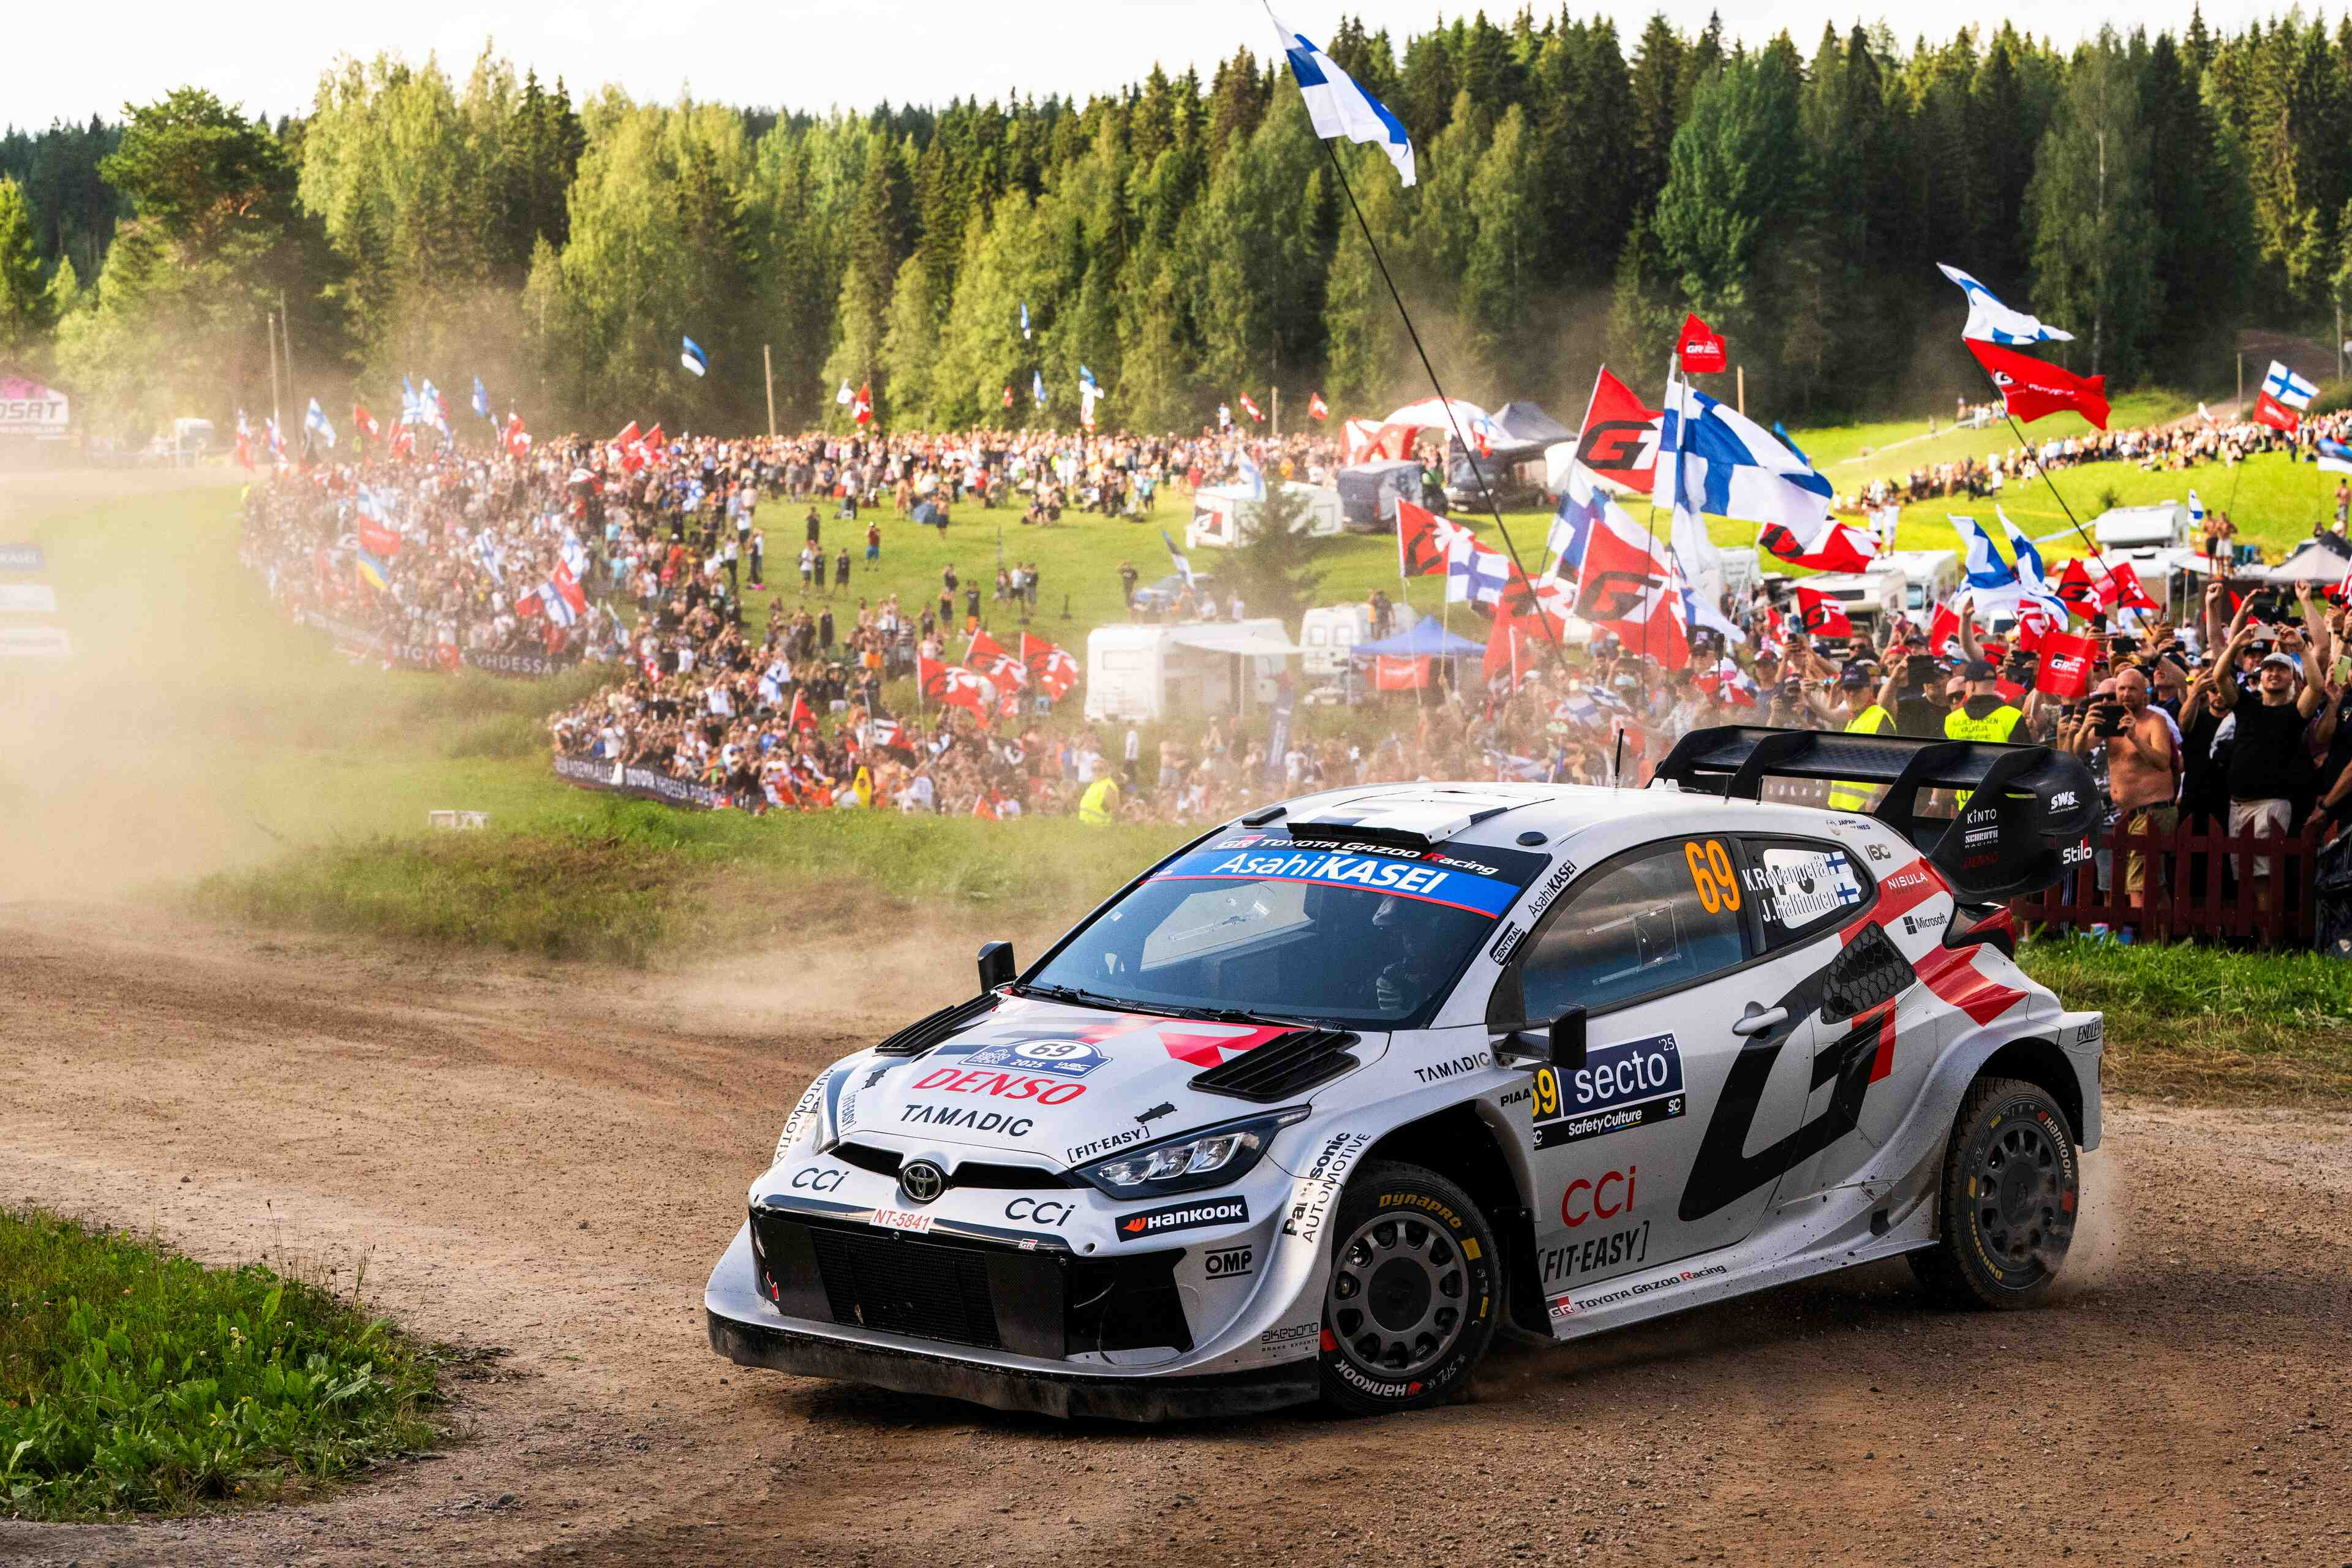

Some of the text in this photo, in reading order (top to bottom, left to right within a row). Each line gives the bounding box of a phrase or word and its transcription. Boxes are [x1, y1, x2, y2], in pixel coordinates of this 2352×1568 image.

[2051, 791, 2075, 809] SWS
[1965, 839, 1999, 848] RACING
[2062, 839, 2093, 864] Stilo
[1210, 853, 1450, 894] AsahiKASEI
[1344, 842, 1421, 858] GAZOO
[1422, 851, 1499, 876] Racing
[1528, 859, 1577, 918] AsahiKASEI
[1684, 839, 1741, 914] 69
[1887, 872, 1928, 890] NISULA
[1915, 912, 1948, 929] Microsoft
[1493, 927, 1522, 963] CENTRAL
[1010, 1059, 1046, 1068] 2025
[1029, 1043, 1077, 1057] 69
[1414, 1051, 1491, 1084] TAMADIC
[1575, 1050, 1668, 1104] secto
[911, 1068, 1087, 1106] DENSO
[1500, 1087, 1531, 1107] PIAA
[900, 1104, 1034, 1137] TAMADIC
[1568, 1109, 1642, 1136] SafetyCulture
[1303, 1133, 1371, 1244] AUTOMOTIVE
[873, 1208, 930, 1230] NT-5841
[1205, 1250, 1253, 1274] OMP
[1575, 1289, 1631, 1310] TOYOTA
[1631, 1276, 1681, 1295] GAZOO
[1679, 1264, 1727, 1281] Racing
